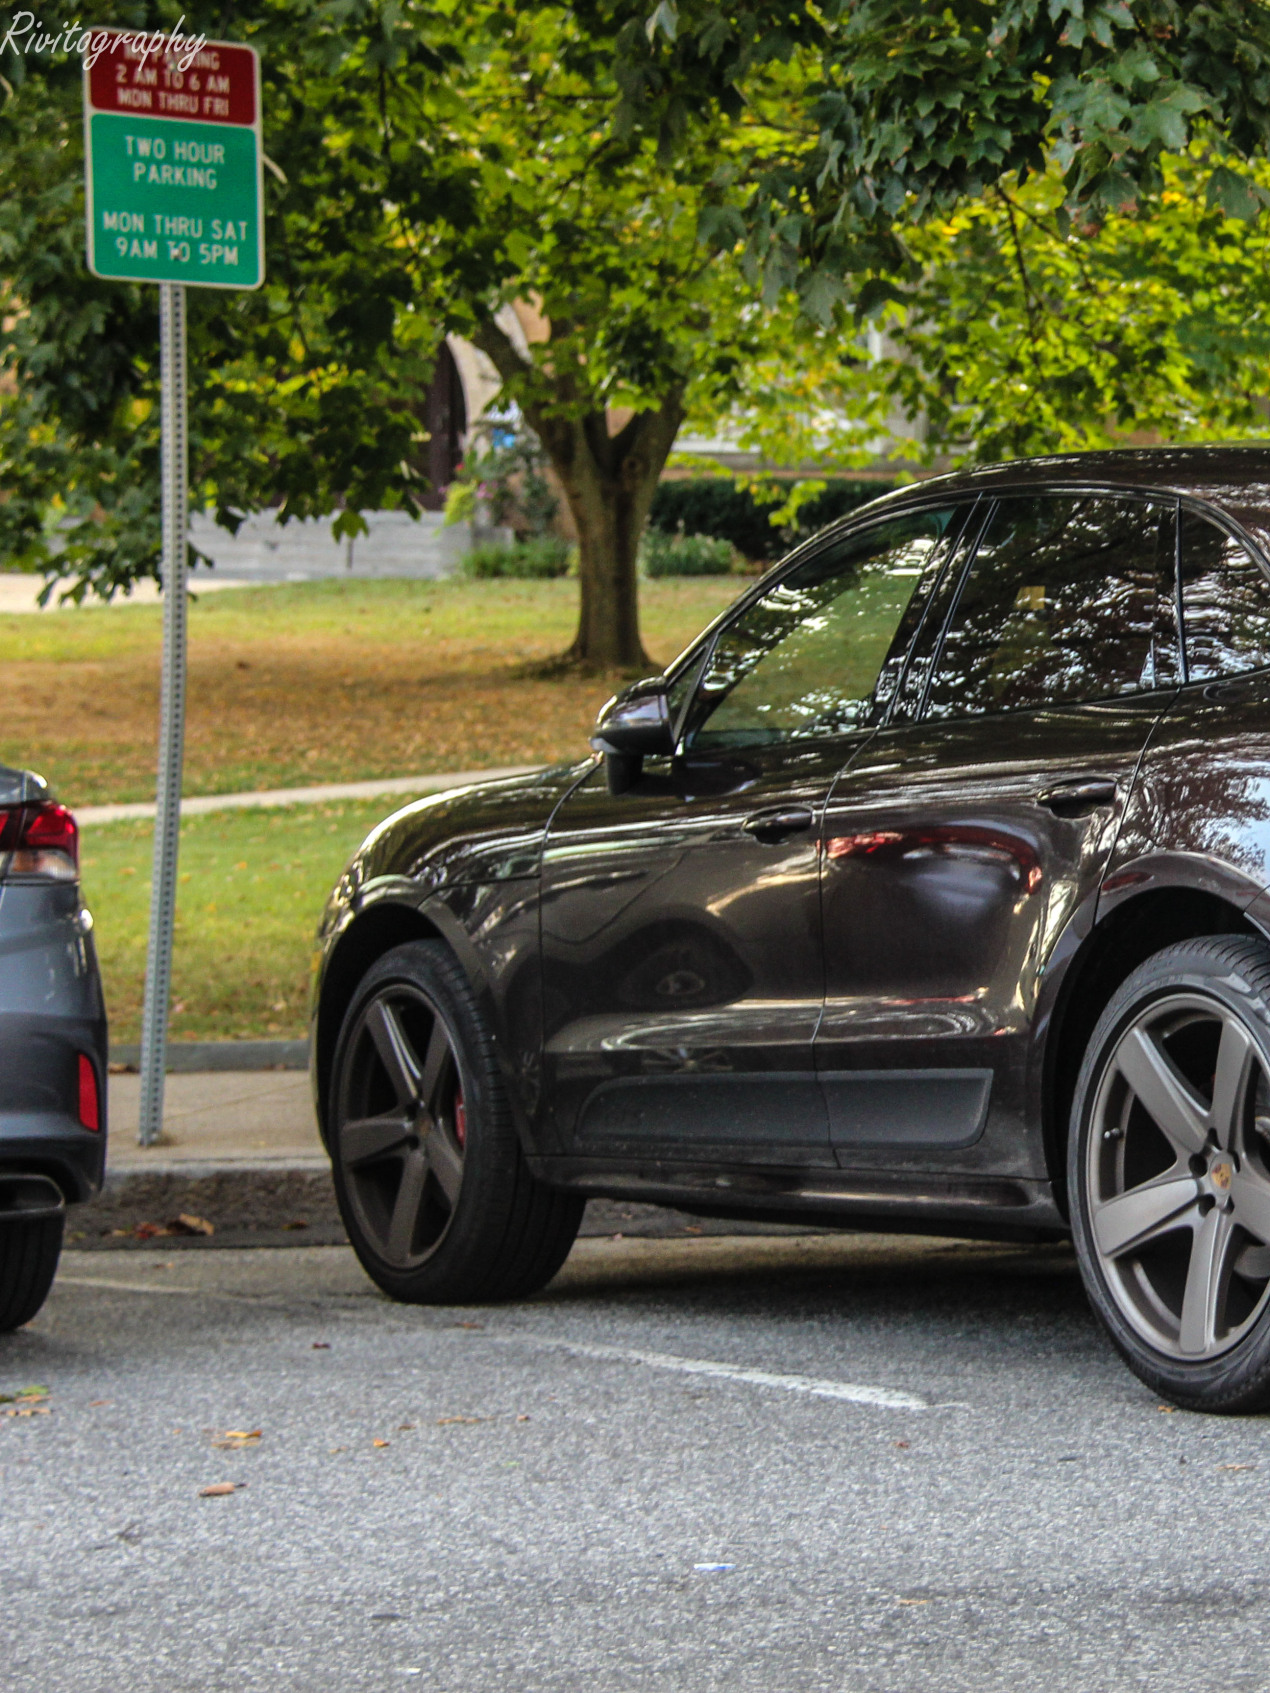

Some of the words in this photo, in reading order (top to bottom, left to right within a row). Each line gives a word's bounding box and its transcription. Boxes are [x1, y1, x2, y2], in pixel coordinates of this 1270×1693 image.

[115, 63, 128, 84] 2
[133, 68, 158, 86] AM
[163, 71, 184, 90] TO
[189, 75, 201, 91] 6
[206, 76, 230, 94] AM
[117, 87, 152, 107] MON
[158, 91, 199, 114] THRU
[203, 97, 230, 117] FRI
[125, 135, 166, 160] TWO
[174, 140, 225, 164] HOUR
[133, 162, 217, 190] PARKING
[103, 210, 145, 233] MON
[154, 214, 203, 238] THRU
[211, 218, 248, 241] SAT
[115, 237, 158, 259] 9AM
[167, 241, 191, 263] TO
[199, 243, 239, 266] 5PM
